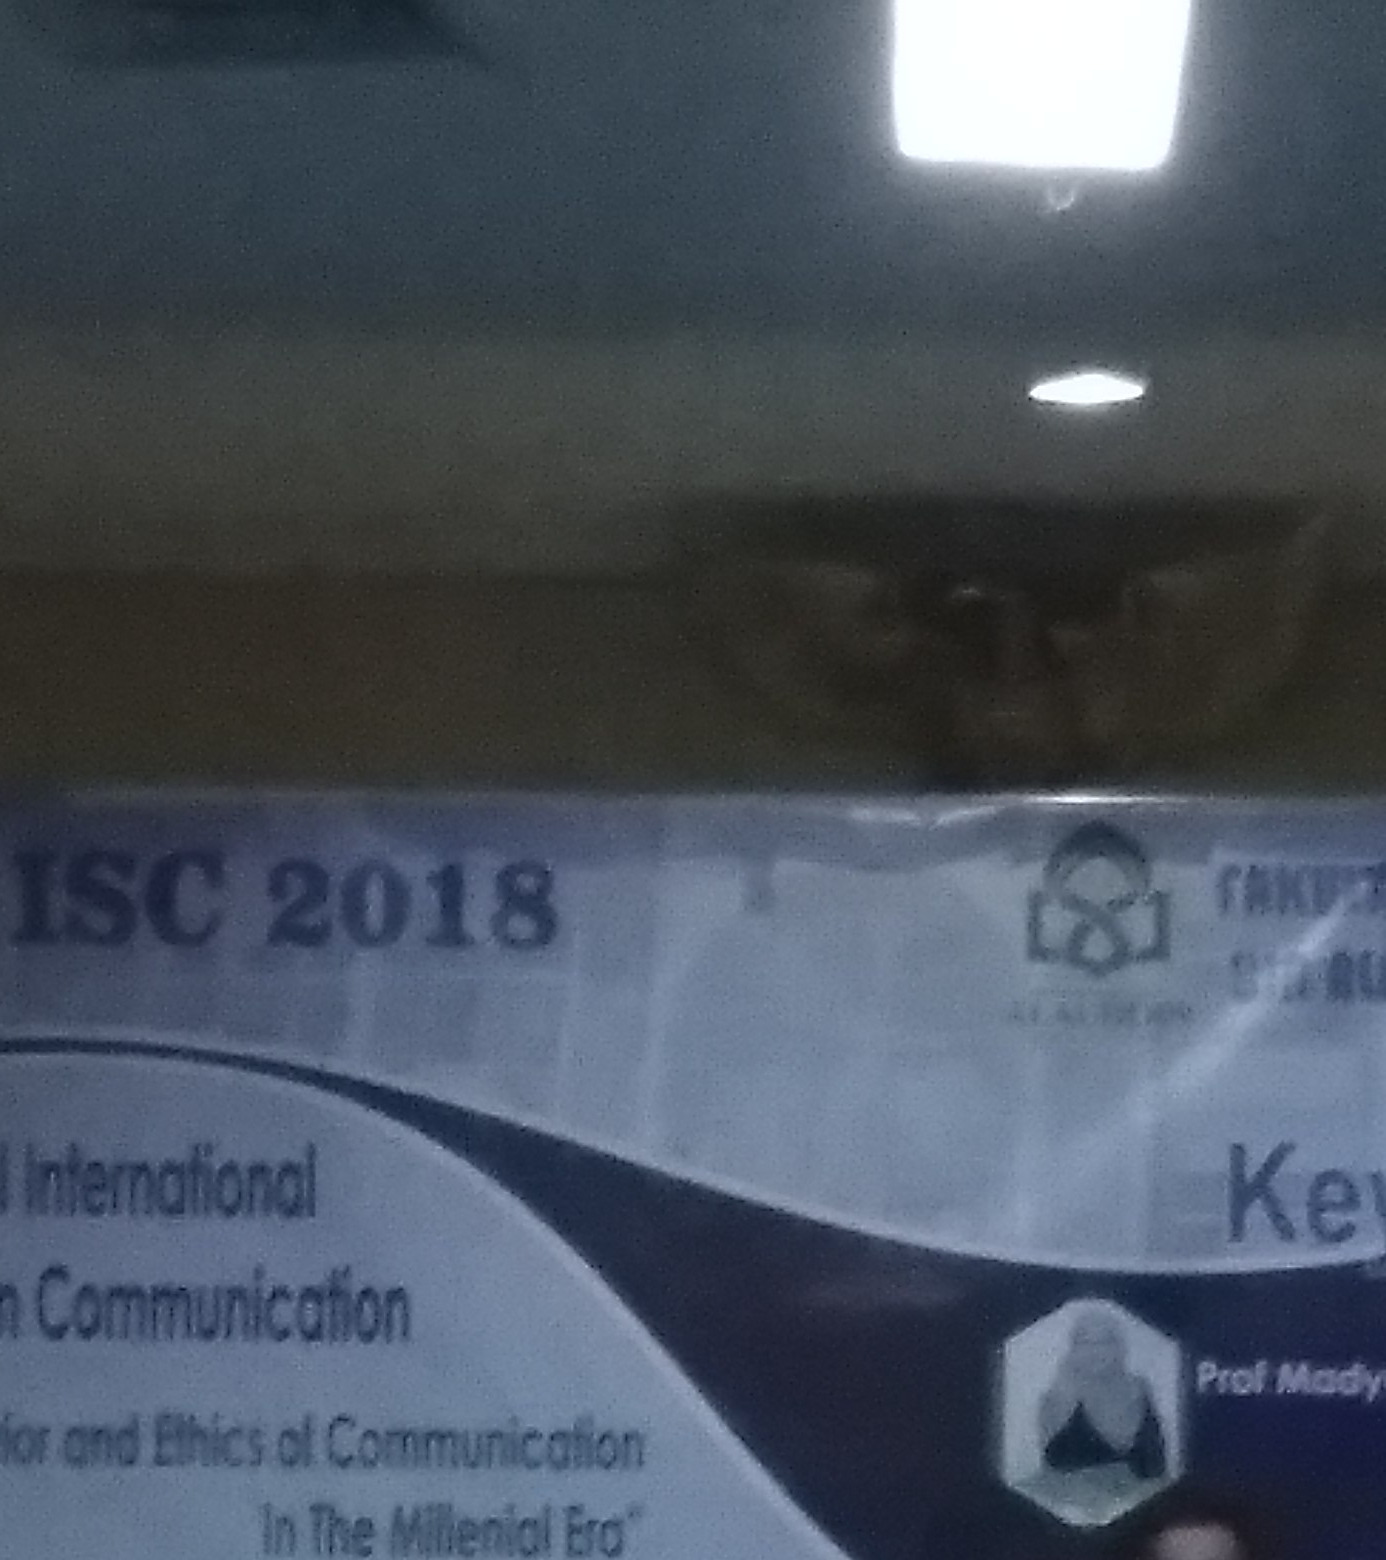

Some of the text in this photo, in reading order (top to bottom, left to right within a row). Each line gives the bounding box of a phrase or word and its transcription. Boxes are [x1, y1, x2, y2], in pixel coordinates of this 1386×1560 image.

[13, 850, 225, 948] ISC
[265, 857, 560, 950] 2018
[22, 1140, 317, 1219] International
[36, 1264, 413, 1342] Communication
[63, 1410, 140, 1466] and
[326, 1412, 646, 1470] Communication
[261, 1502, 297, 1558] In
[311, 1501, 375, 1559] The
